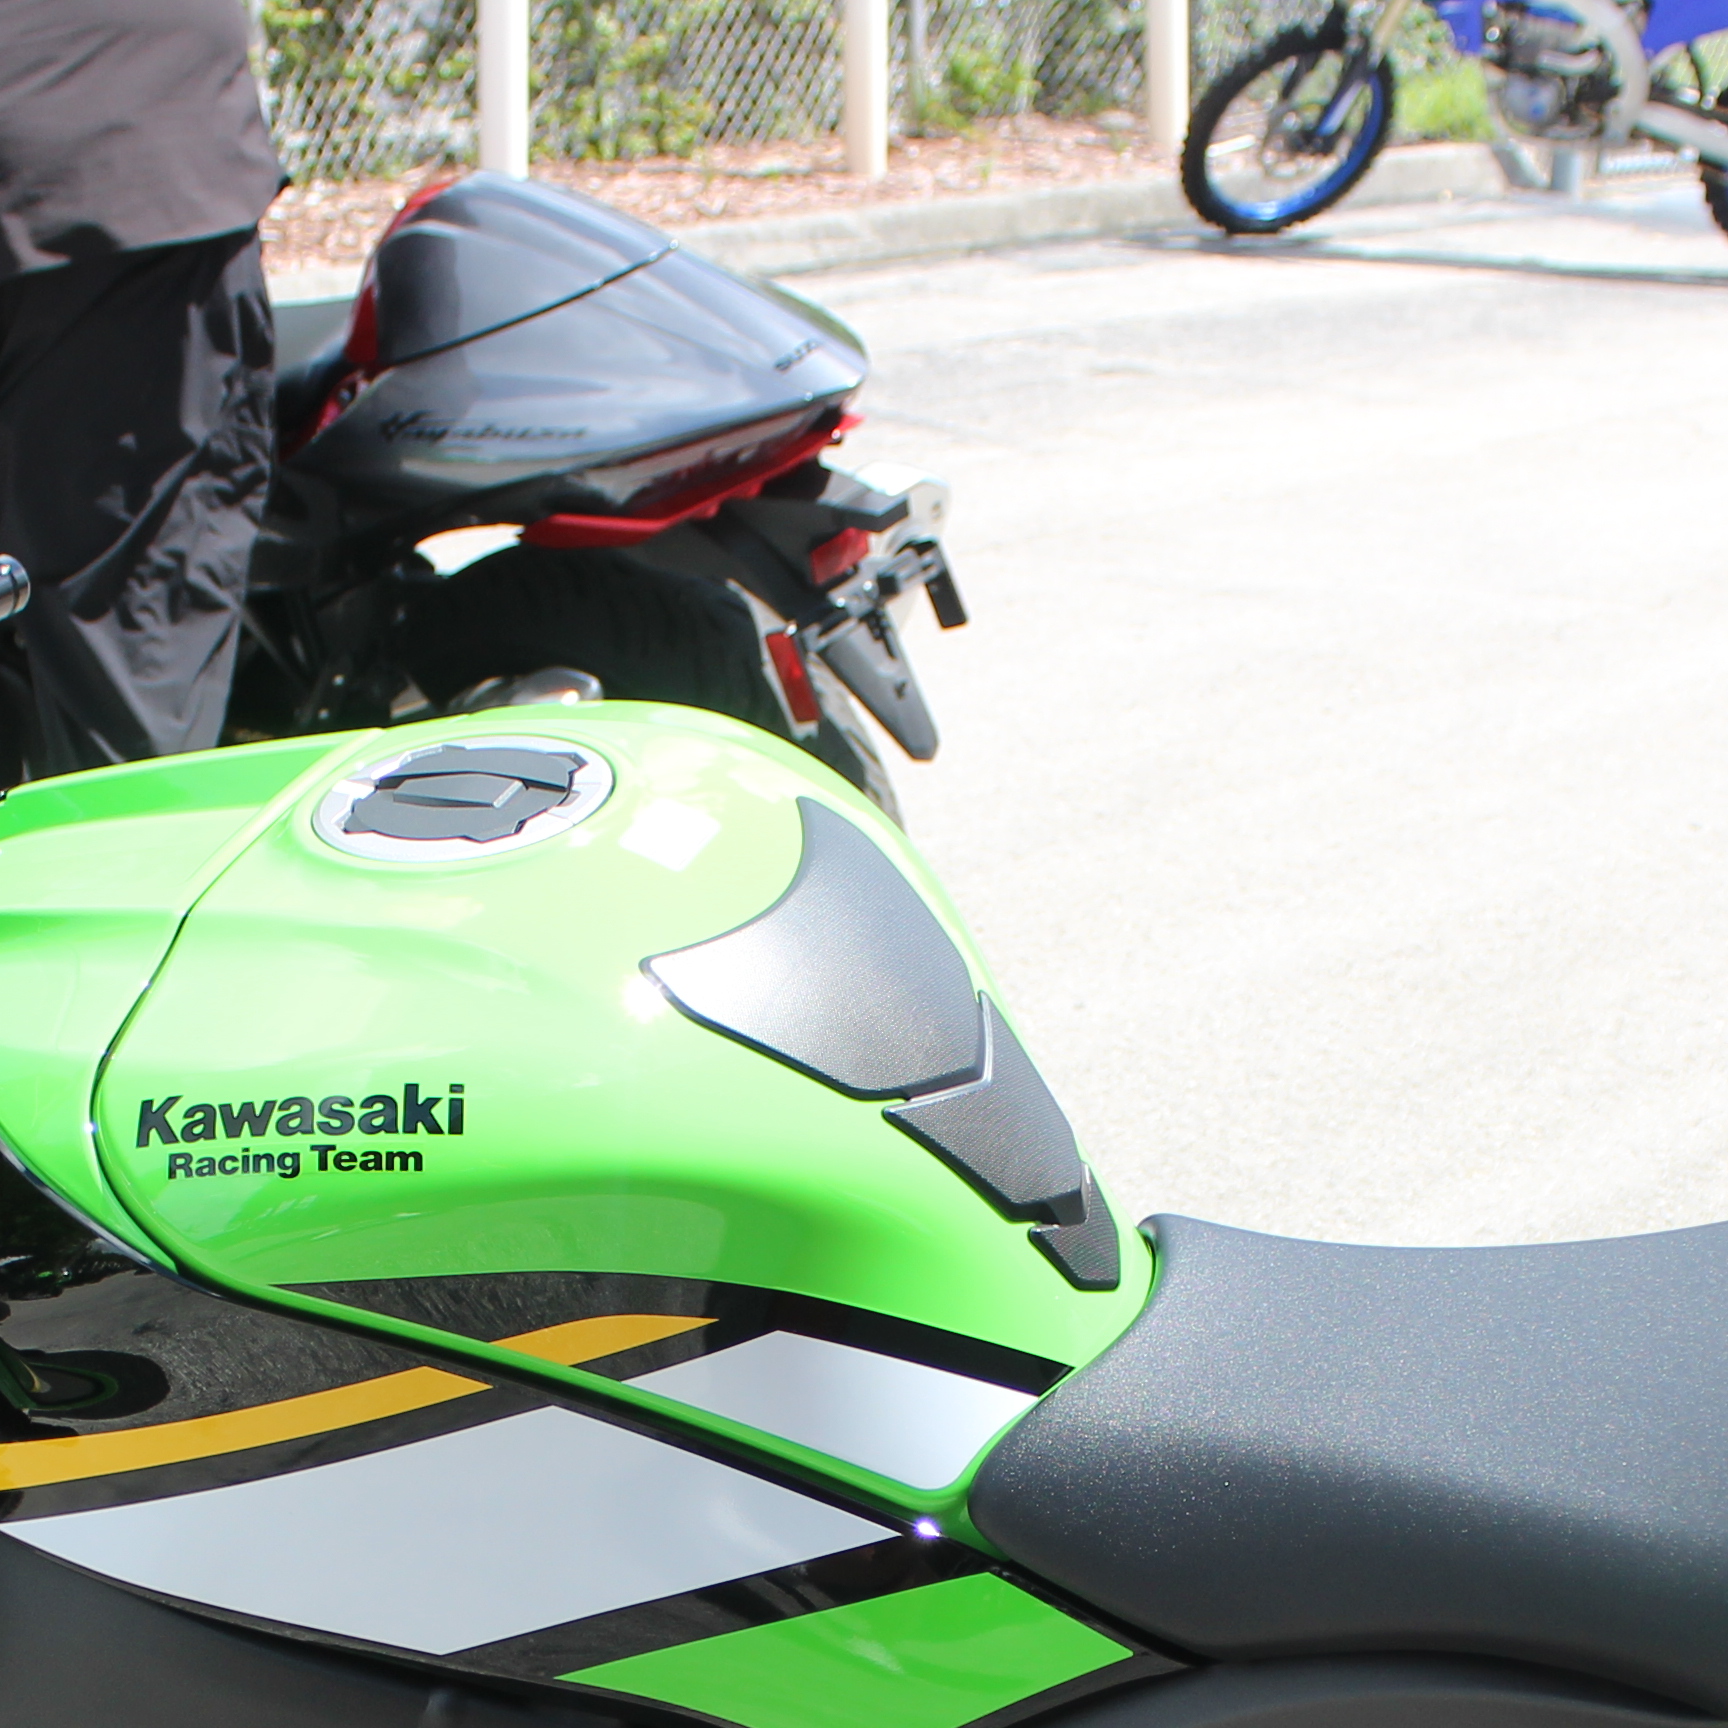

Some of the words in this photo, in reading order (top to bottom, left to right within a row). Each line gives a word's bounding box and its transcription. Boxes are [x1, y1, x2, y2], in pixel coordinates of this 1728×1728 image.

[135, 1082, 465, 1148] Kawasaki
[167, 1147, 301, 1180] Racing
[310, 1144, 424, 1173] Team
